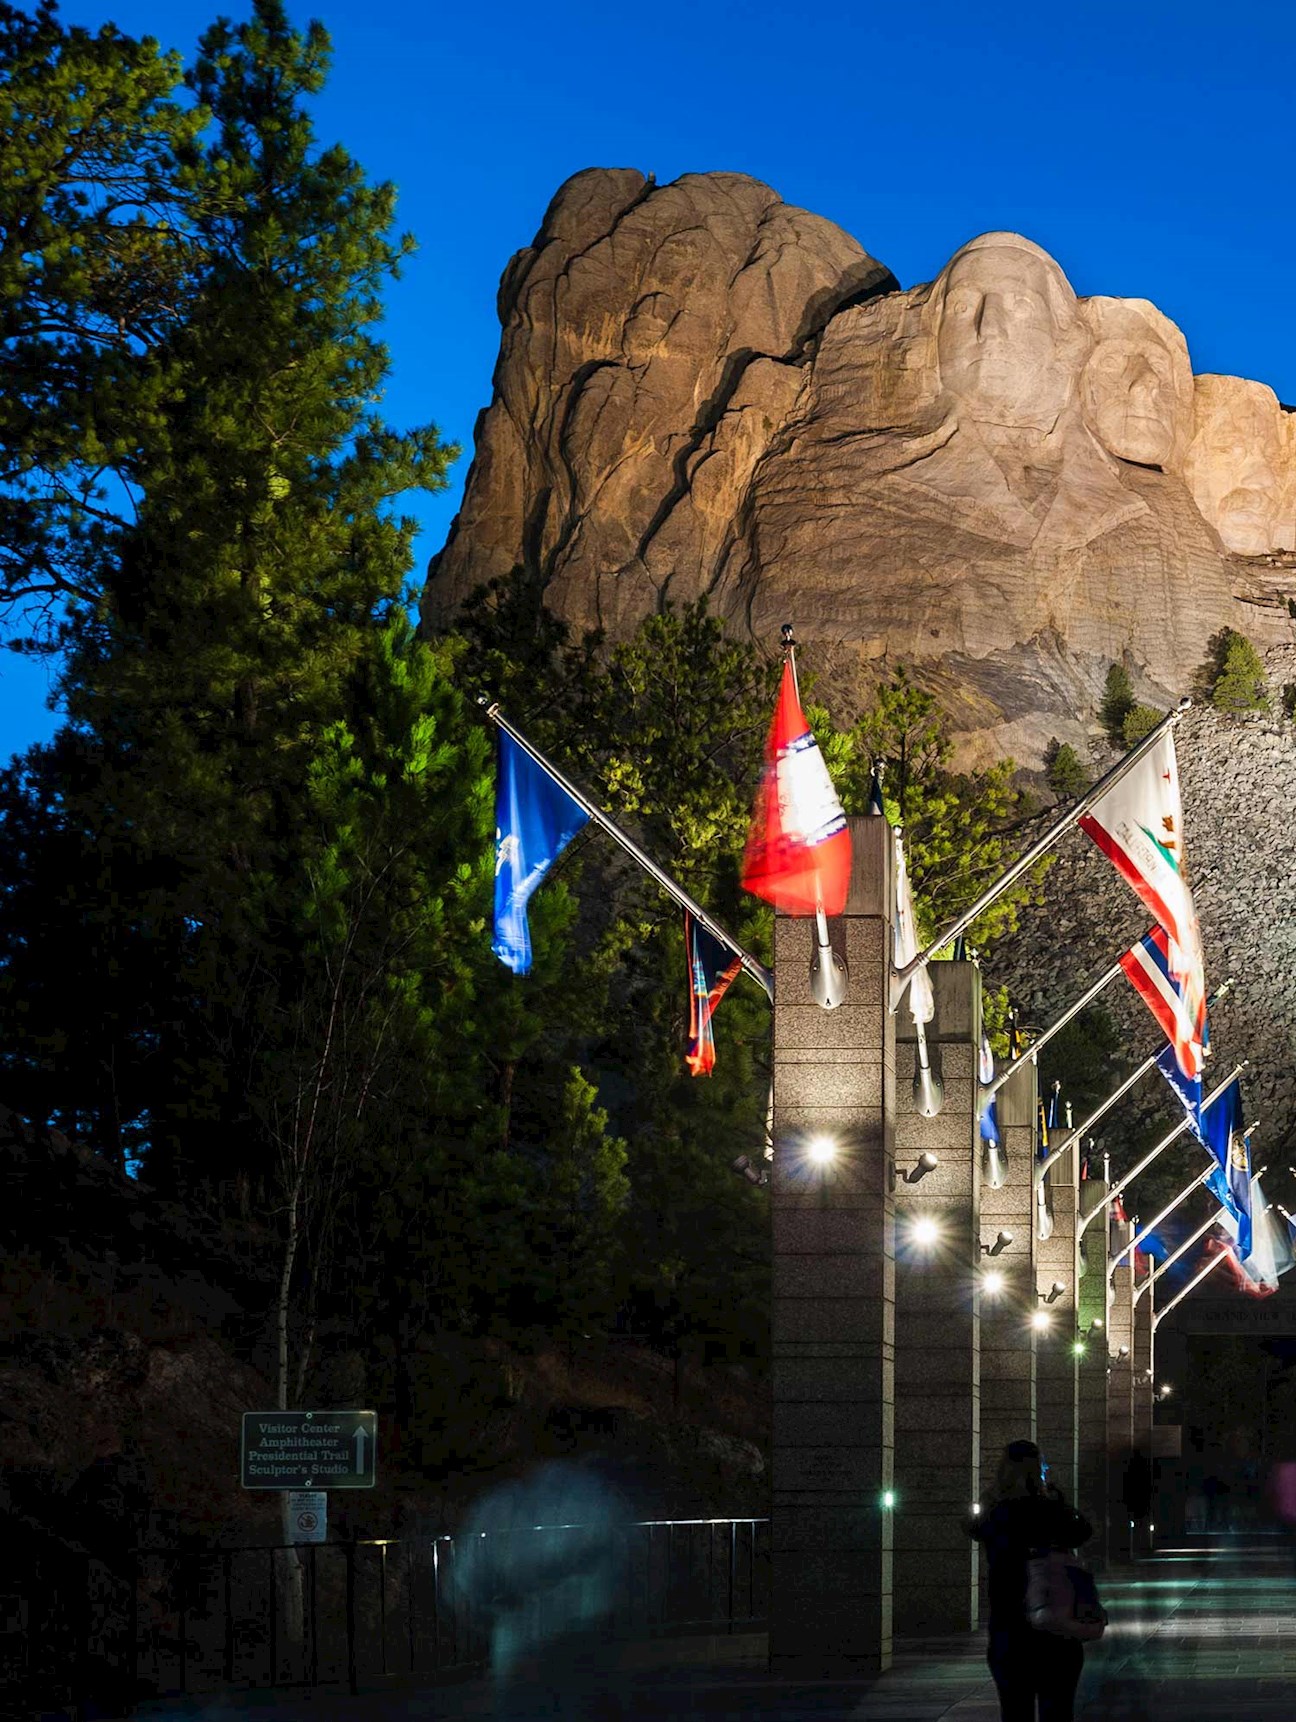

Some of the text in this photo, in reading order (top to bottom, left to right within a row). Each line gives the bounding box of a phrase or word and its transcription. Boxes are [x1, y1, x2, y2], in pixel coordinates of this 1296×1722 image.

[259, 1423, 340, 1433] Visitor Center
[259, 1437, 339, 1449] Amphitheater
[248, 1450, 349, 1461] Presidential Trail
[248, 1464, 349, 1477] Sculptor's Studio
